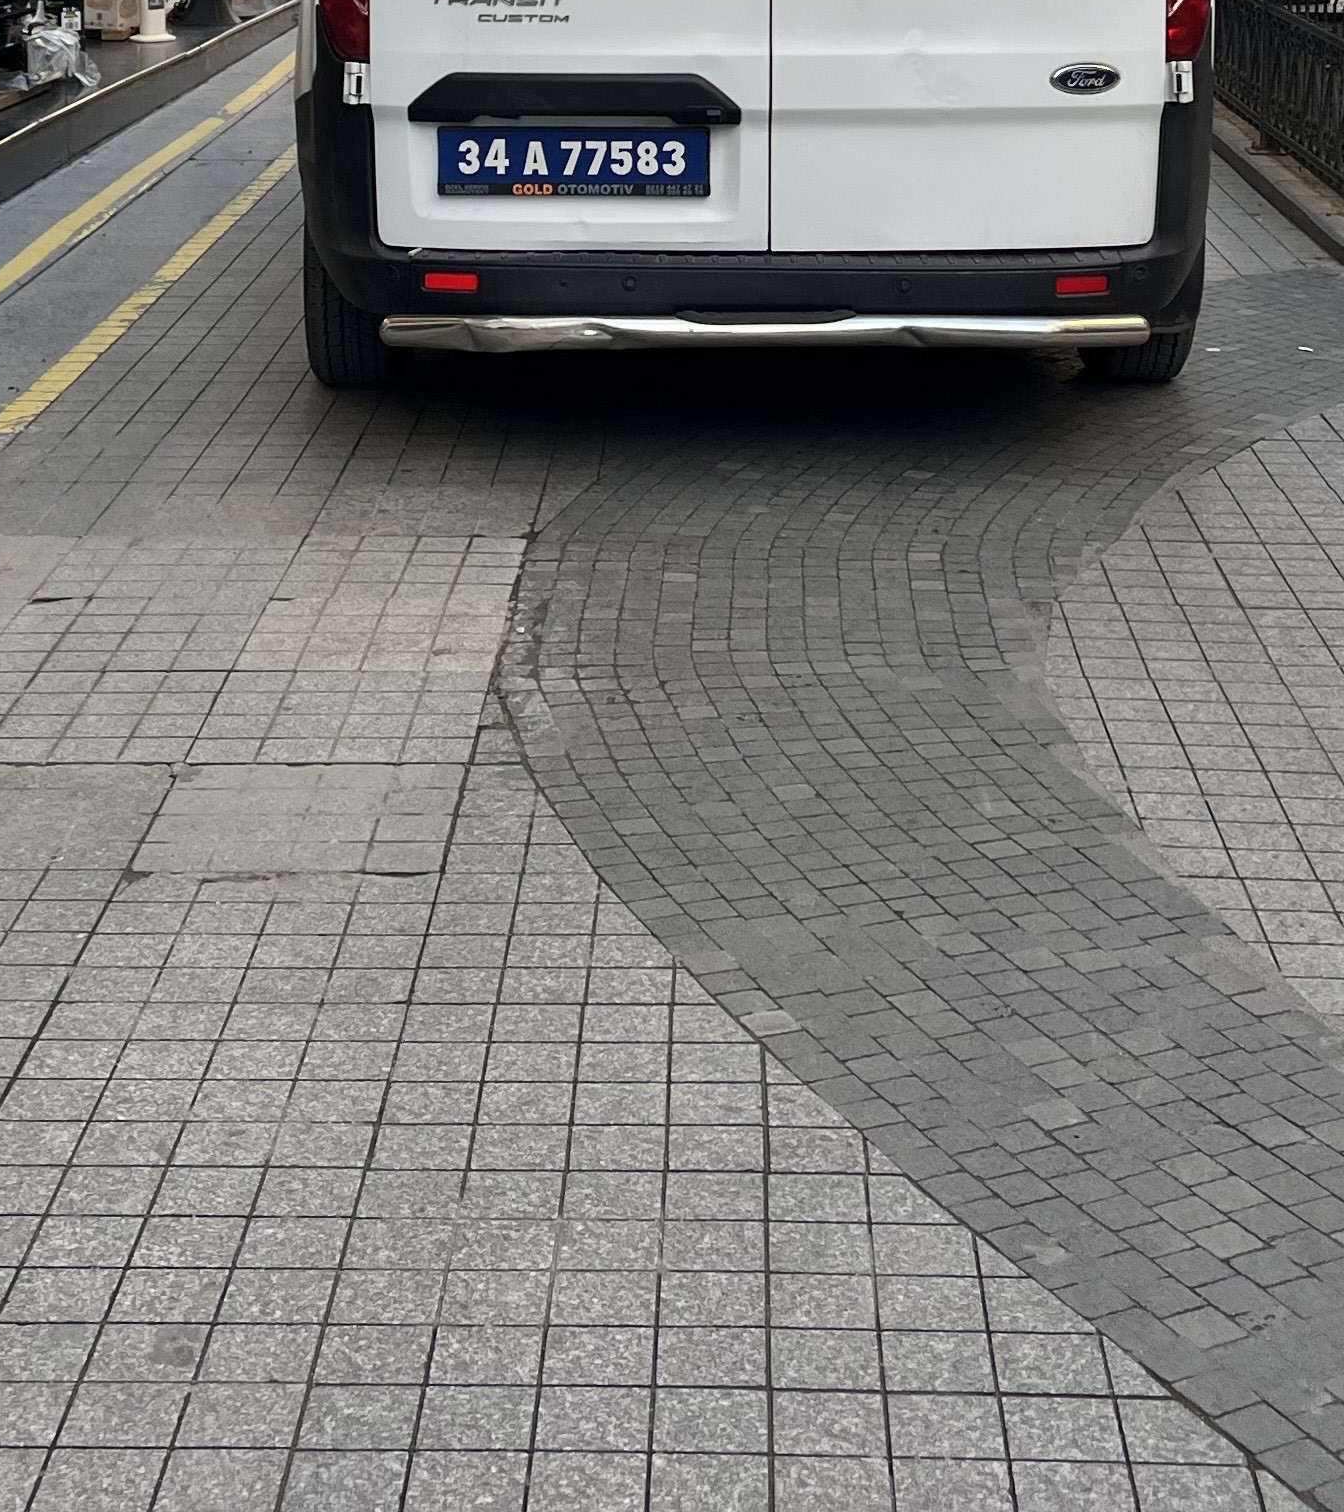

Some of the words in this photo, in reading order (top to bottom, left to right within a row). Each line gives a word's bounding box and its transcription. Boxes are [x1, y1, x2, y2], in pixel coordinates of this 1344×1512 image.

[477, 13, 570, 24] CUSTOM
[1066, 69, 1106, 89] Ford
[457, 138, 510, 176] 34
[523, 140, 549, 176] A
[560, 140, 686, 177] 77583
[512, 183, 553, 195] GOLD
